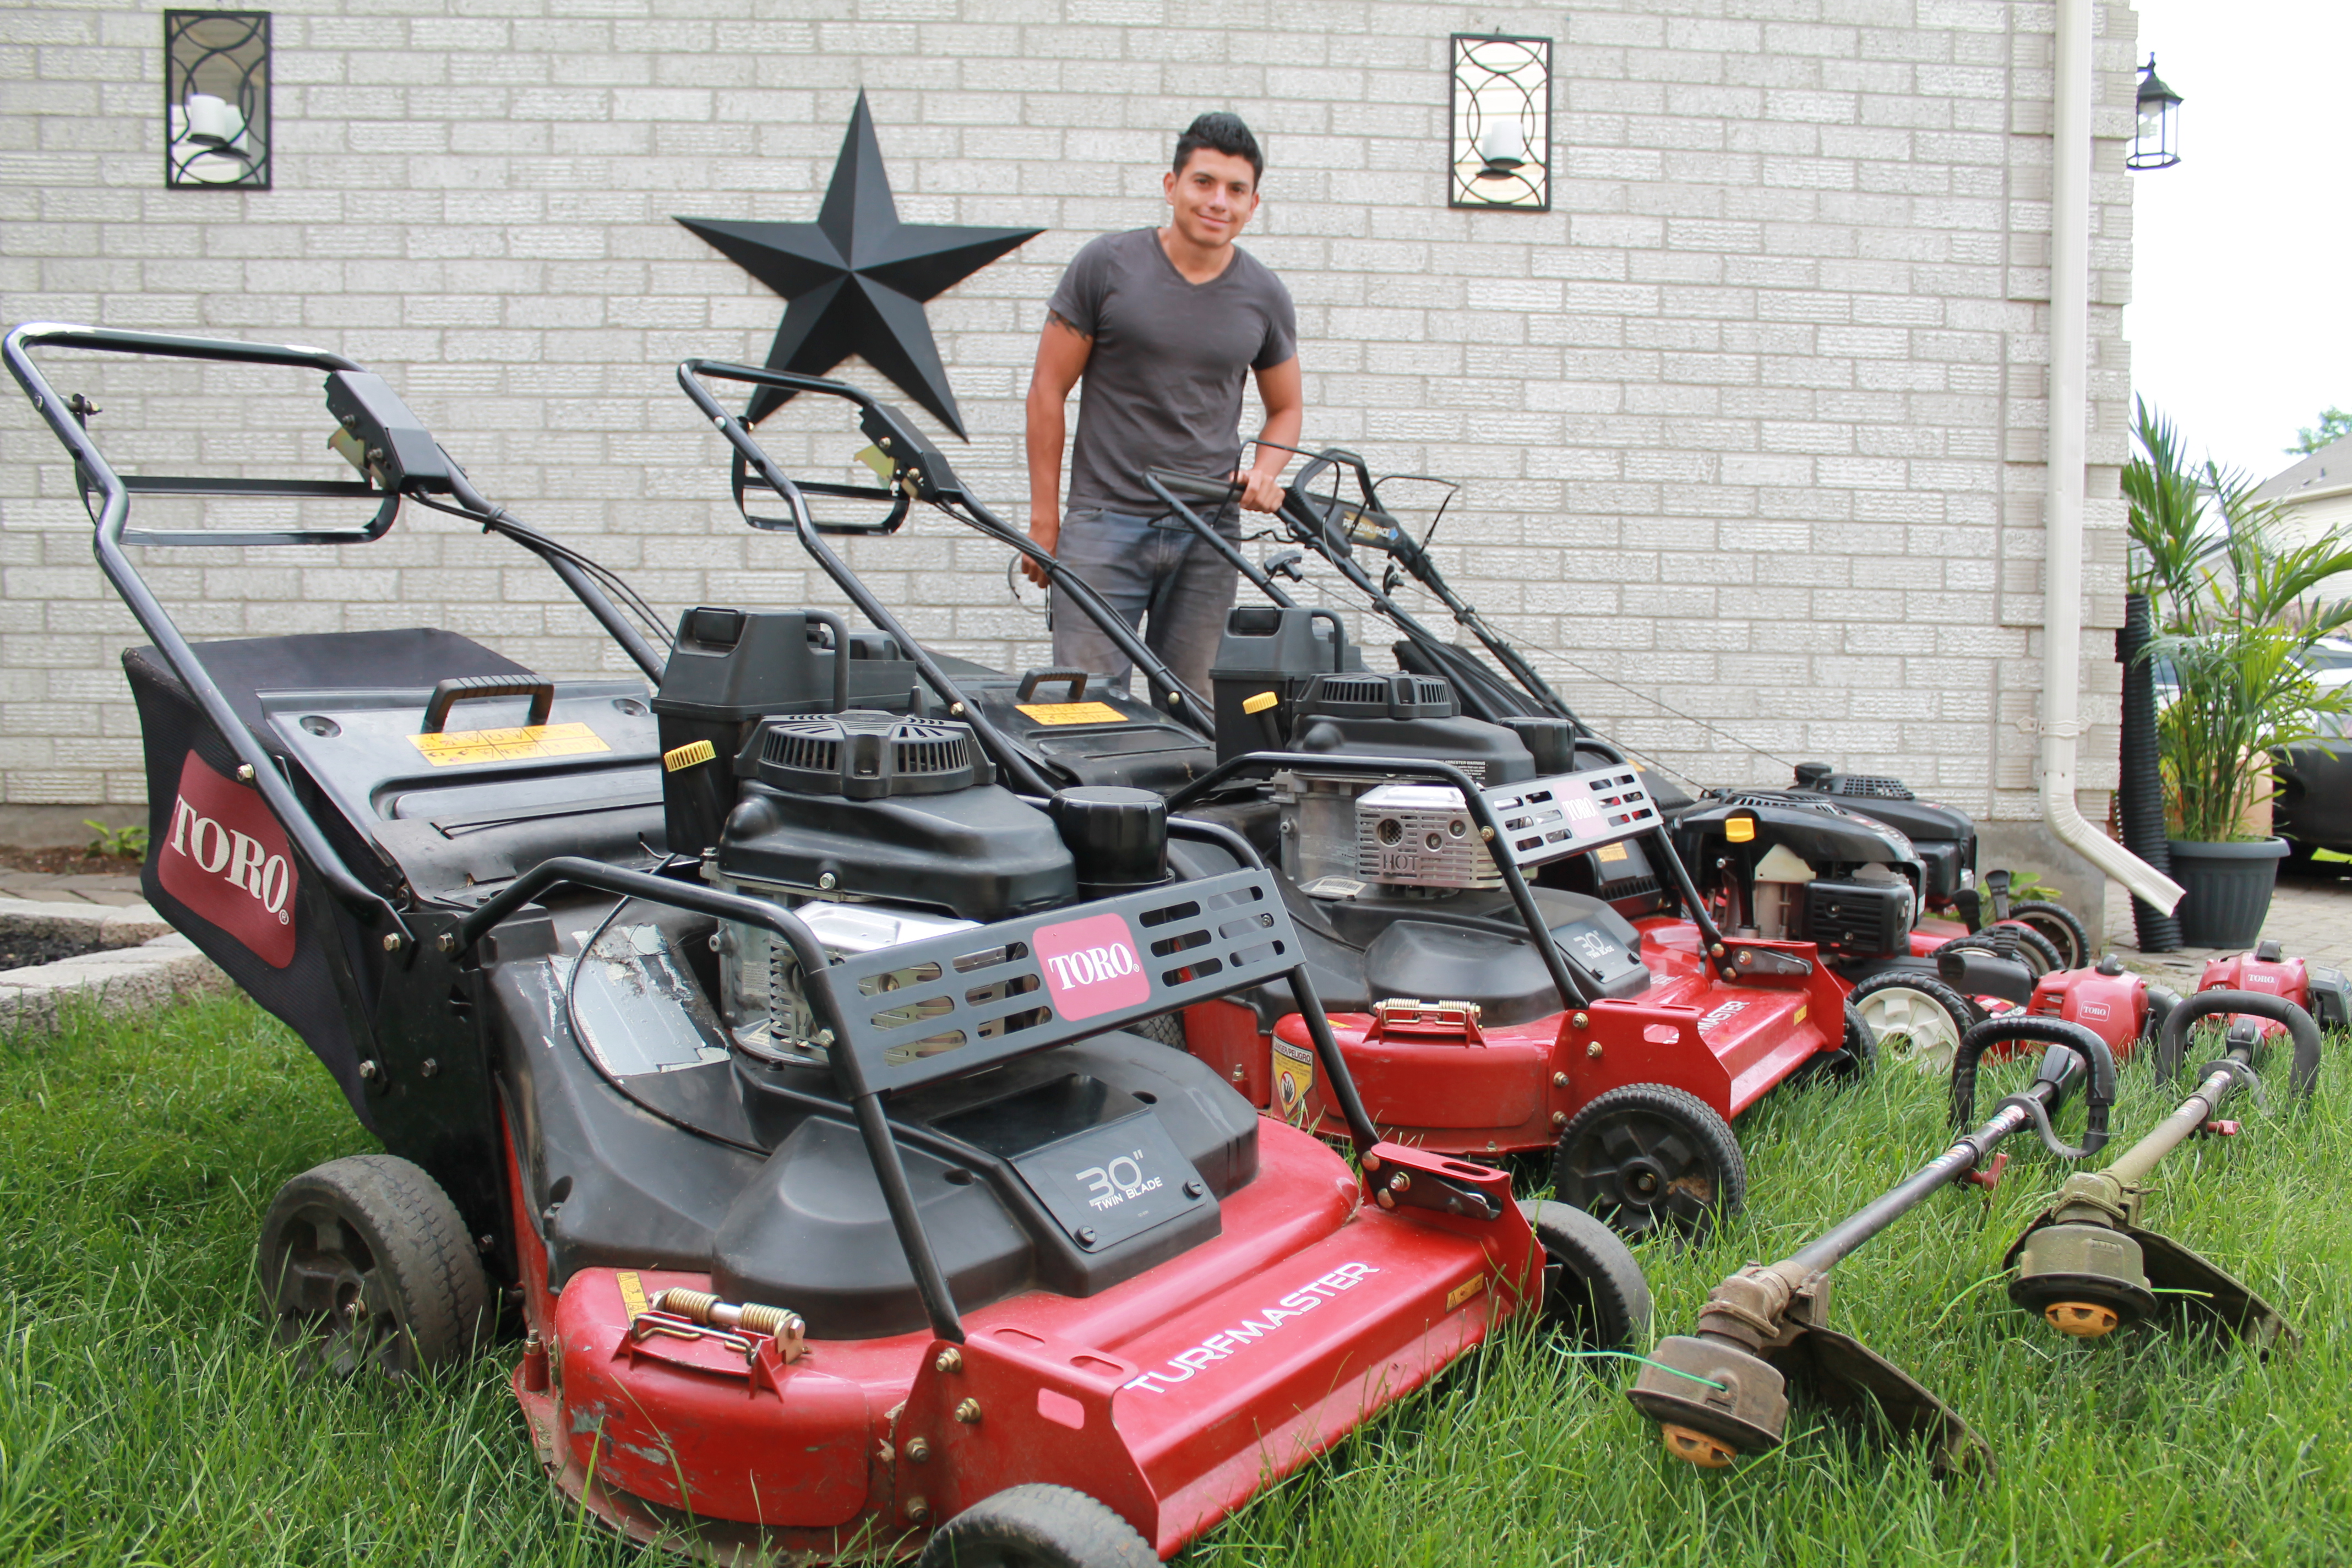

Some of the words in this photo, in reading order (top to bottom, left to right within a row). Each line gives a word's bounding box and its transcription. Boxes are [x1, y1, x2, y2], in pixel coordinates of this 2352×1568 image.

[1562, 797, 1596, 821] TORO
[171, 794, 289, 913] TORO
[1383, 854, 1419, 872] HOT
[1048, 943, 1133, 990] TORO
[2248, 974, 2274, 983] TORO
[2083, 1006, 2106, 1016] TORO
[1075, 1149, 1144, 1207] 30"
[1095, 1193, 1124, 1211] TWIN
[1126, 1177, 1163, 1199] BLADE
[1123, 1262, 1380, 1393] TURFMASTER
